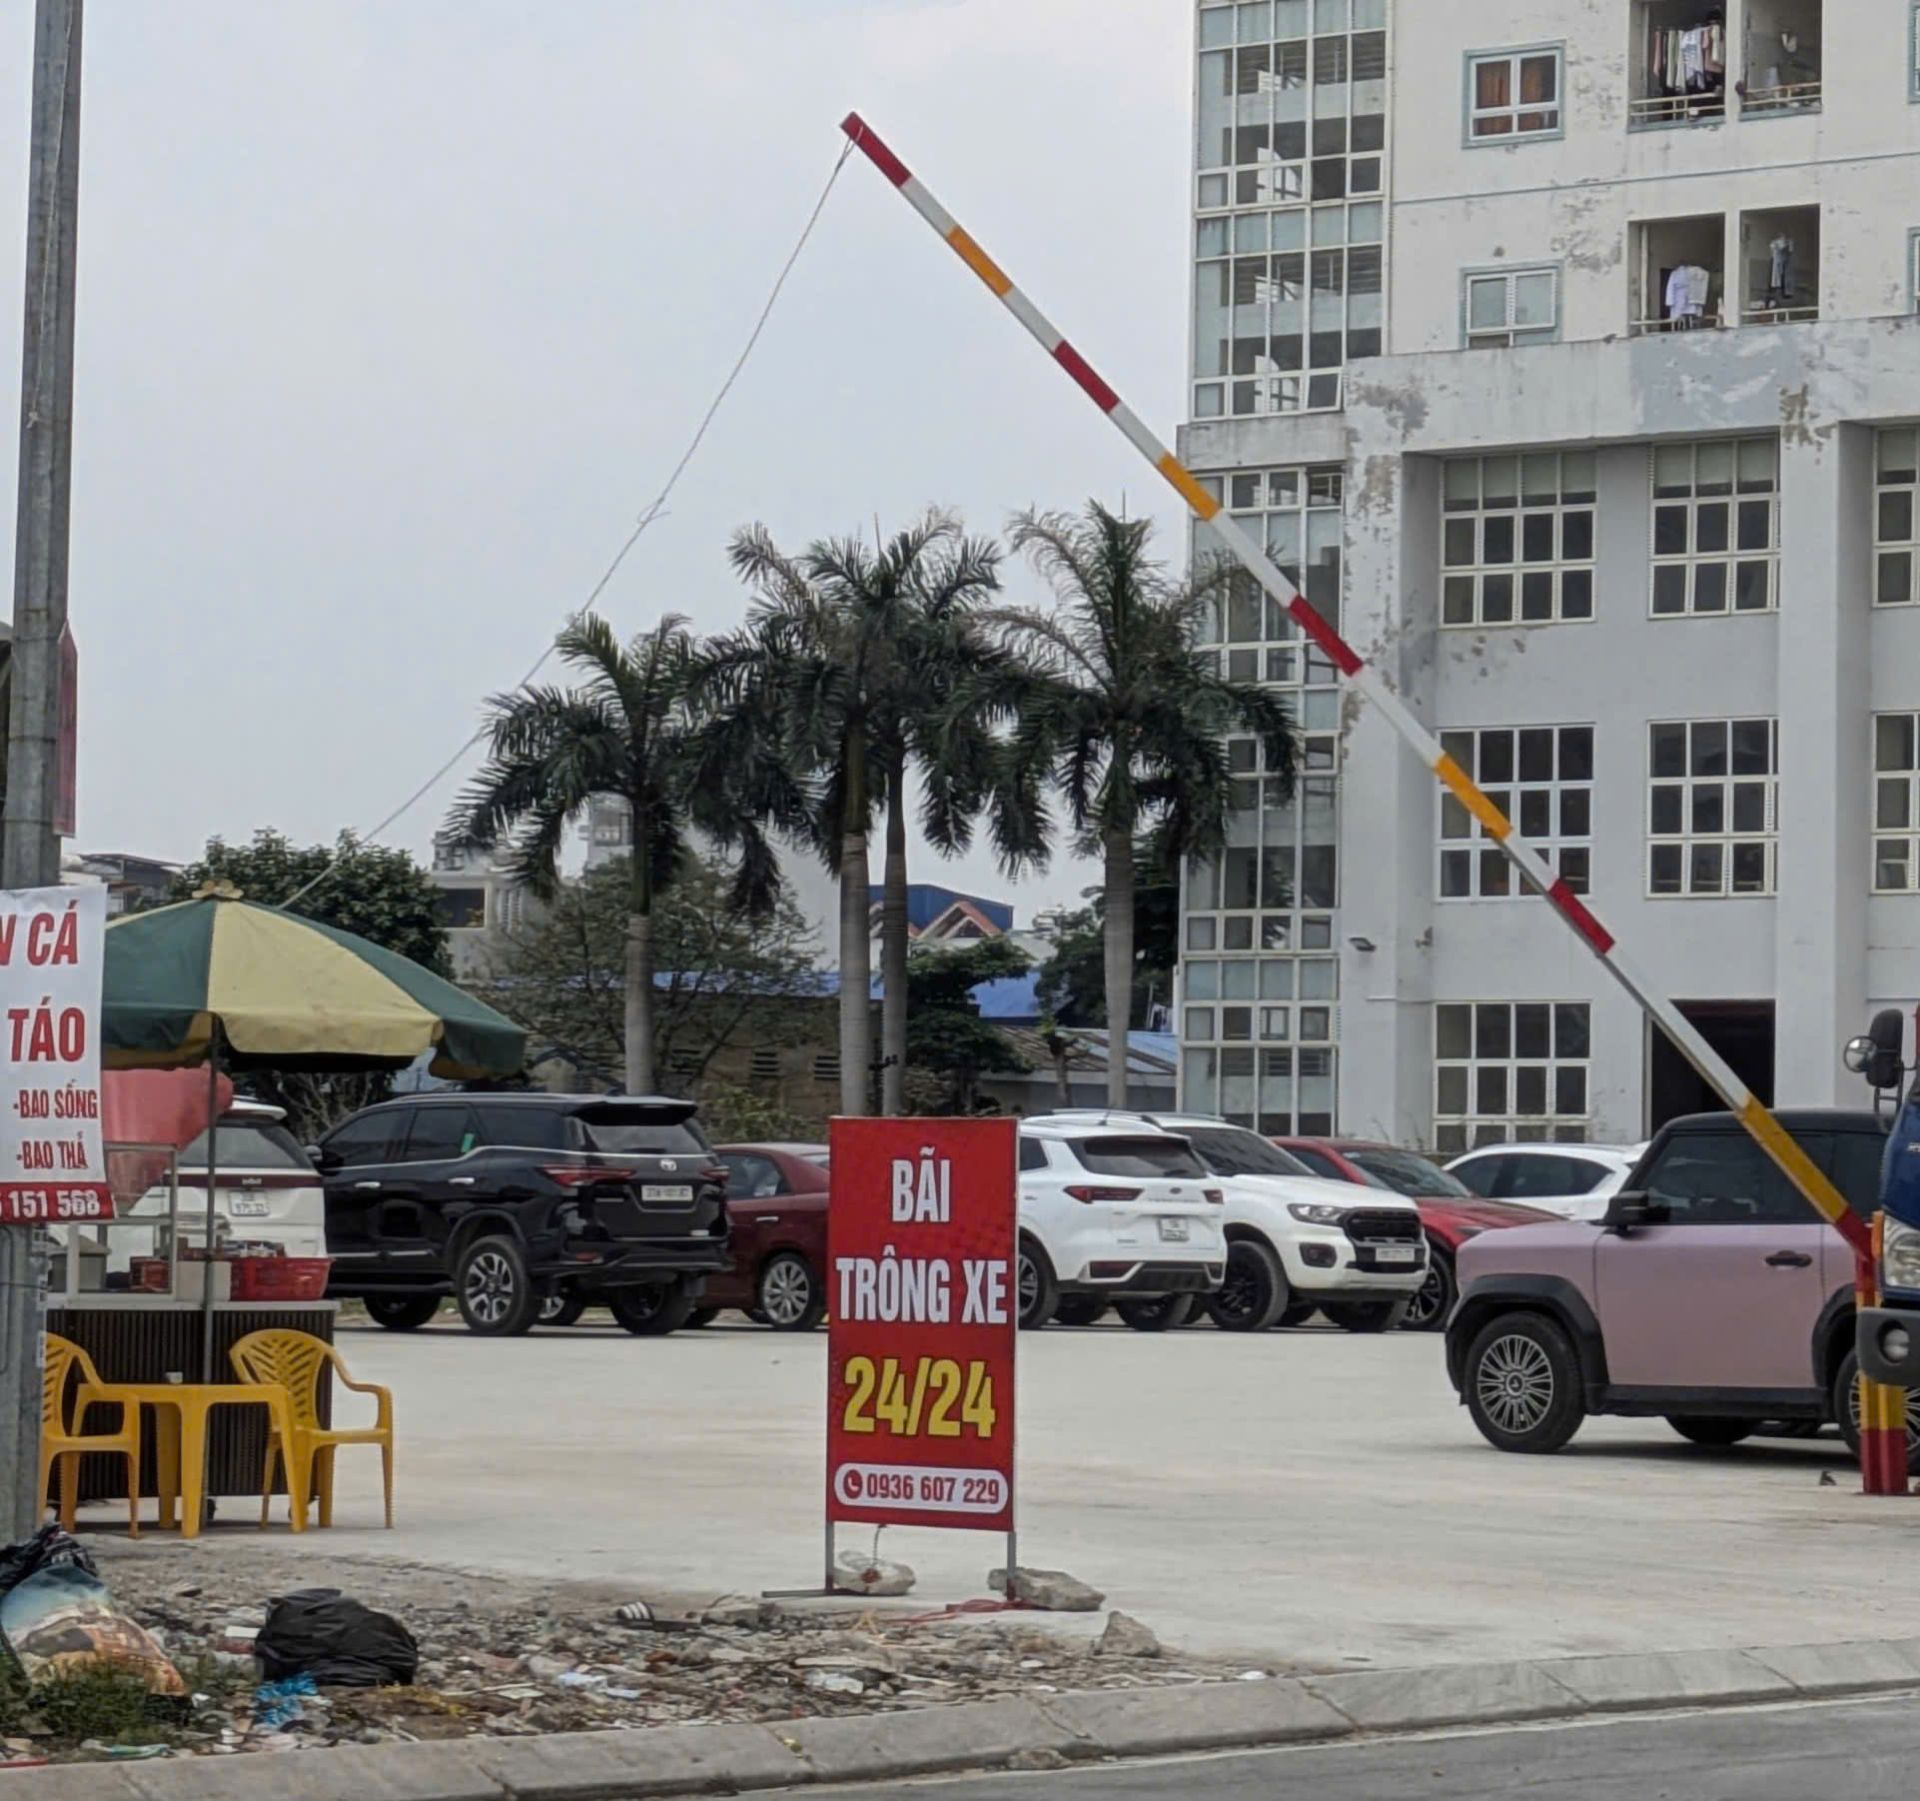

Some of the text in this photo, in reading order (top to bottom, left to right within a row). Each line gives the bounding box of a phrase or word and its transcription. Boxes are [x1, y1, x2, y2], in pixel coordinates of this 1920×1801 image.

[27, 899, 79, 966] CÁ
[7, 995, 85, 1062] TÁO
[8, 1190, 48, 1218] 151
[892, 1146, 951, 1222] BÃI
[835, 1244, 1008, 1324] TRÔNG XE
[843, 1356, 996, 1438] 24/24
[866, 1473, 999, 1504] 0936 607 229
